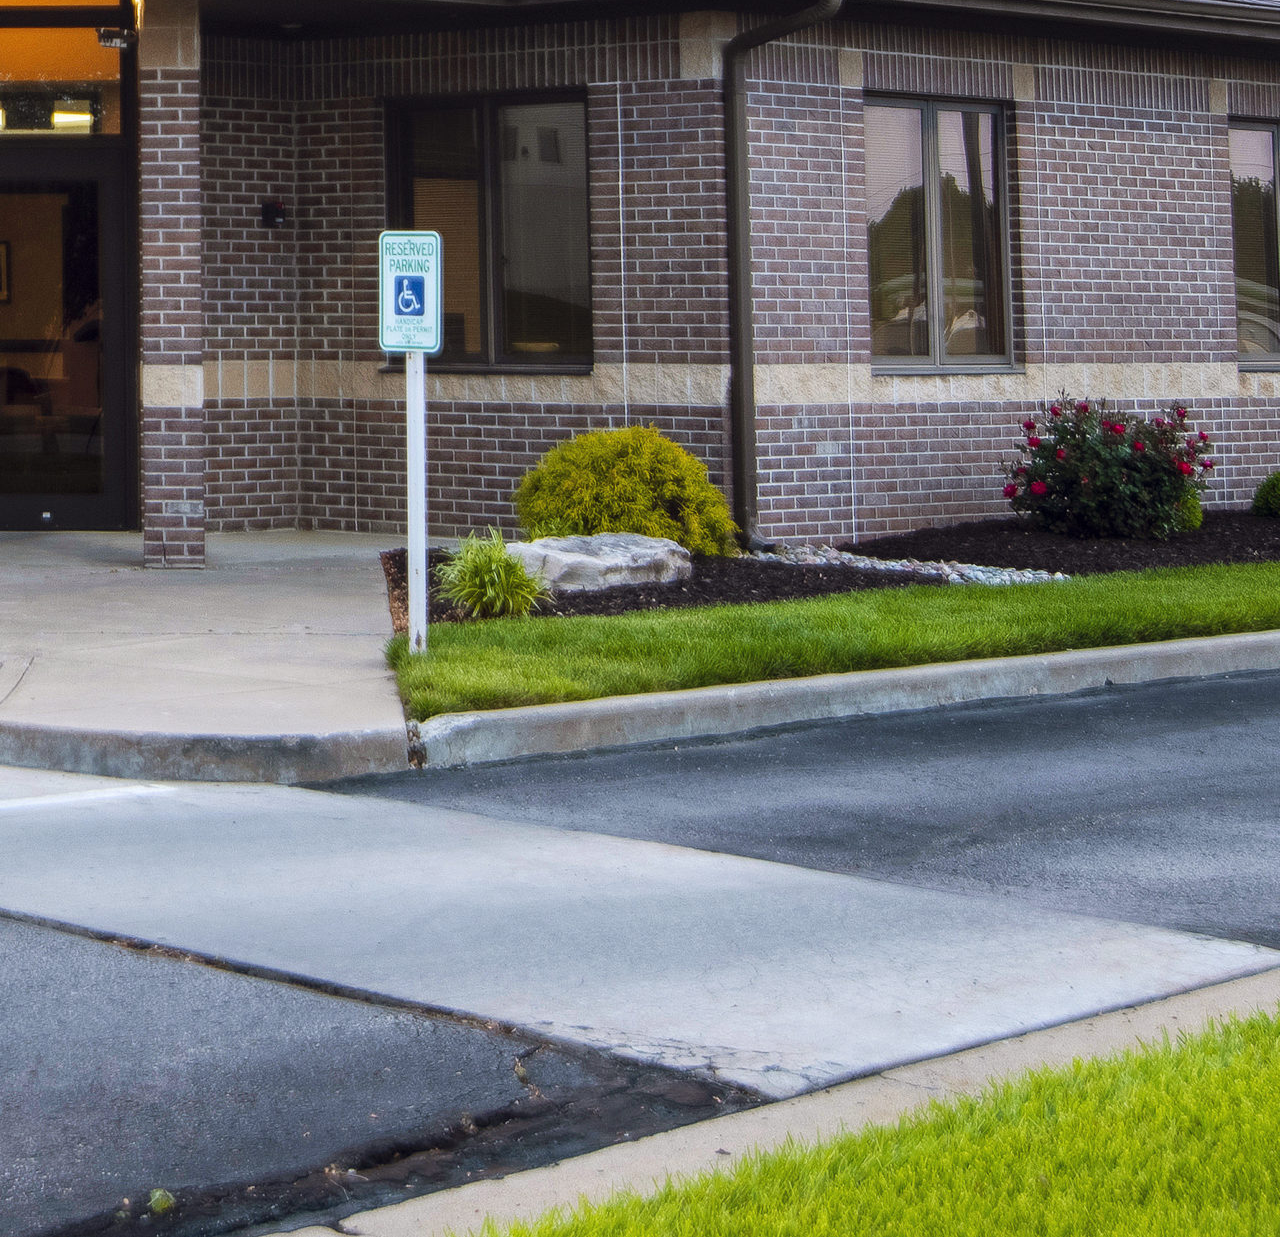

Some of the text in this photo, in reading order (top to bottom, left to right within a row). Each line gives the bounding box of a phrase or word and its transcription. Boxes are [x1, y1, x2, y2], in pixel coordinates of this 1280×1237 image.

[385, 242, 434, 257] RESERVED
[389, 259, 430, 273] PARKING
[413, 325, 433, 333] PERMIT
[402, 332, 417, 340] ONLY
